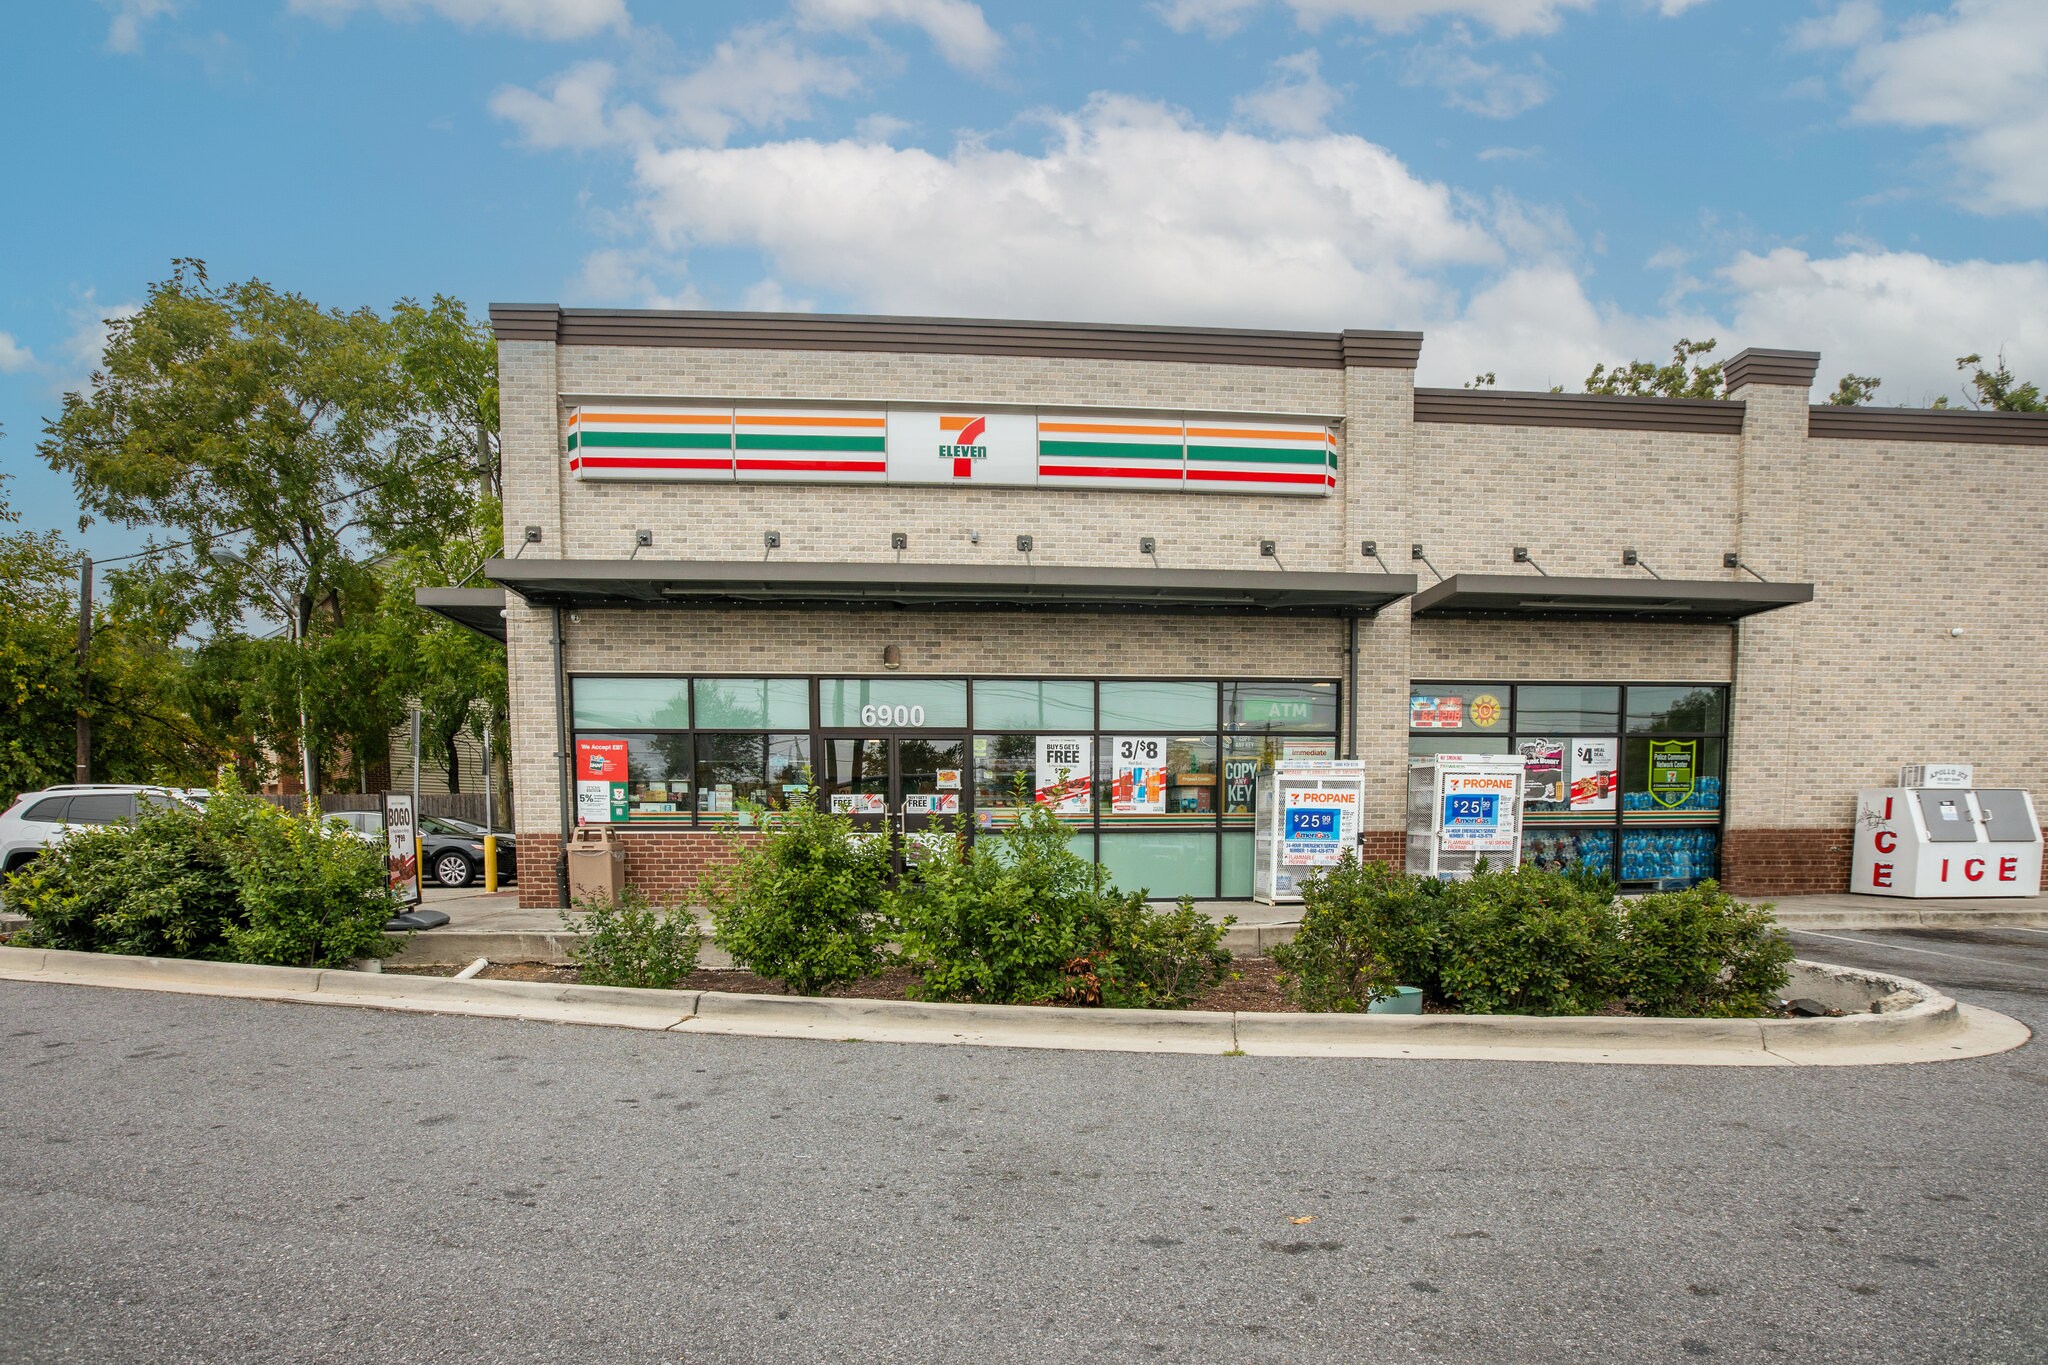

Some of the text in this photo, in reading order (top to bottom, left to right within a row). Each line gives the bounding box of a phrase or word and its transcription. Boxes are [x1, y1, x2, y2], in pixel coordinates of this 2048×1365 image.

[940, 416, 985, 477] 7
[861, 705, 925, 726] 6900
[1269, 703, 1307, 717] ATM
[1047, 751, 1080, 763] FREE
[1121, 740, 1158, 760] 3/$8
[1577, 747, 1593, 764] $4
[1226, 763, 1257, 779] COPY
[1463, 779, 1513, 789] PROPANE
[580, 794, 594, 803] 5%
[1228, 785, 1253, 801] KEY
[1303, 793, 1356, 803] PROPANE
[388, 808, 410, 826] BOGO
[1872, 797, 1897, 888] ICE
[1941, 857, 2018, 882] ICE
